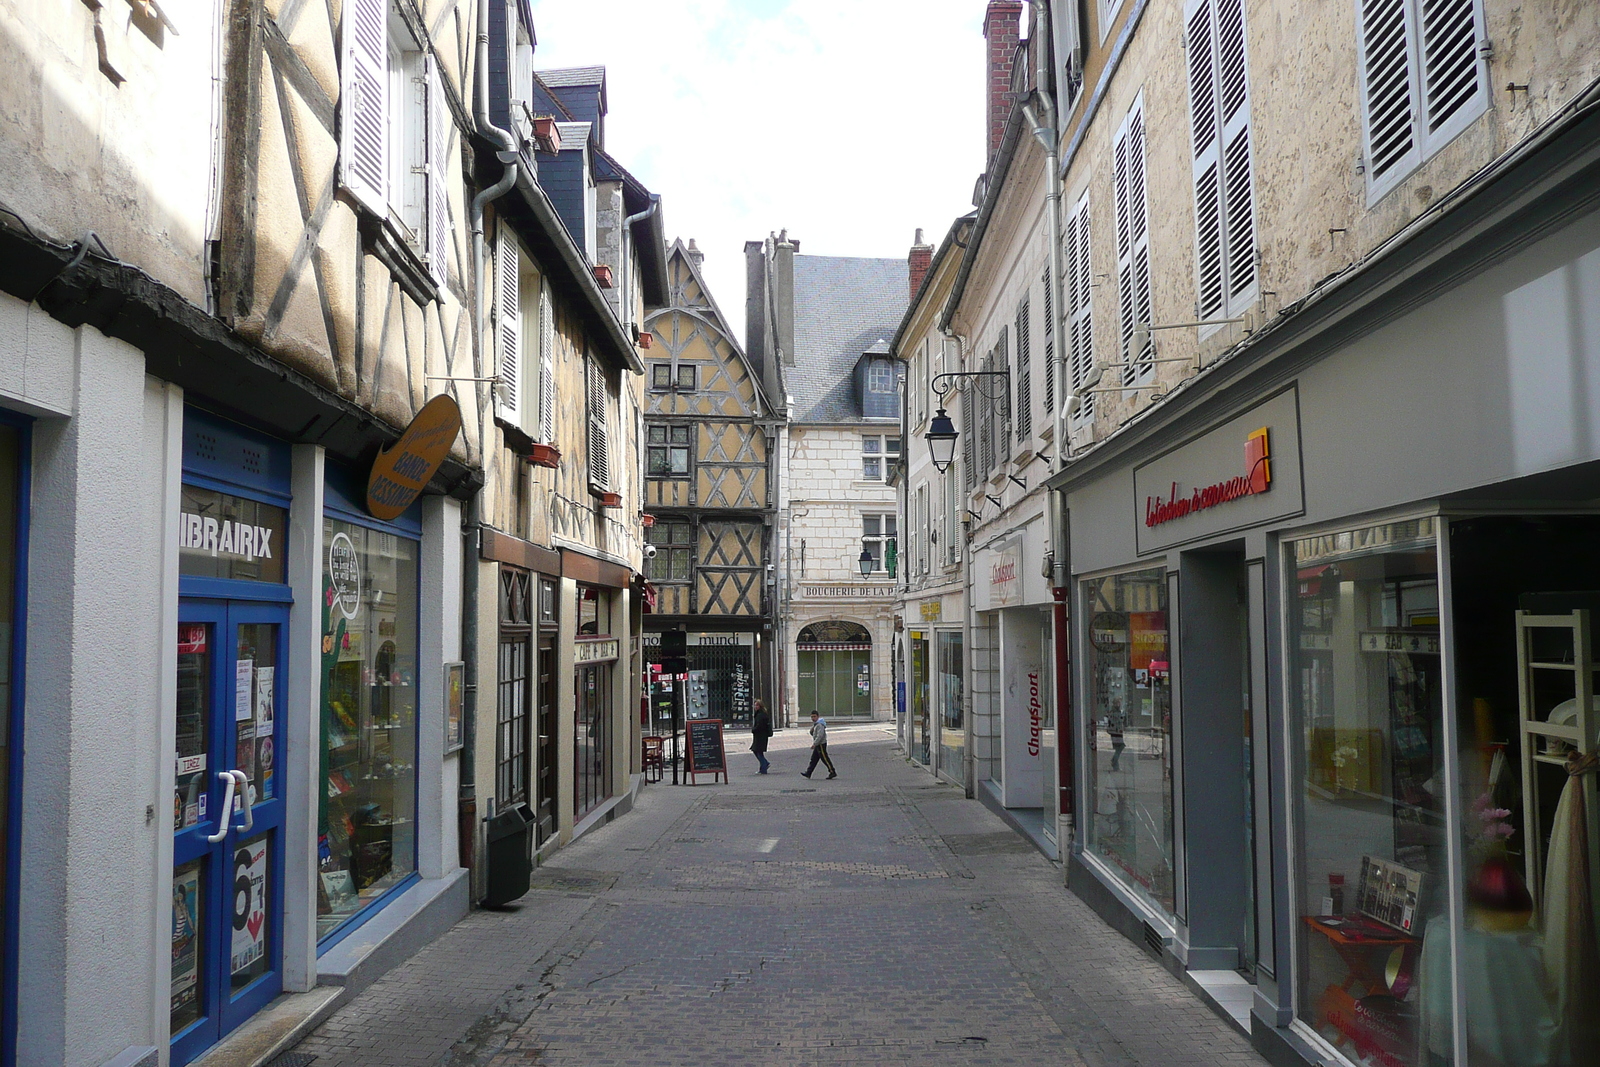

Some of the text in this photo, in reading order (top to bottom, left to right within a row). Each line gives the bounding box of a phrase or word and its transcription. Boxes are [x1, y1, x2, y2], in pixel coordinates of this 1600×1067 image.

[393, 451, 431, 482] BANDE
[1201, 475, 1255, 510] carreaux
[180, 512, 272, 562] IBRAIRIX
[806, 587, 856, 596] BOUCHERIE
[859, 587, 870, 596] DE
[873, 587, 884, 596] LA
[699, 636, 739, 646] mundi
[734, 663, 748, 704] Disques
[1028, 672, 1041, 757] Chausport
[183, 757, 200, 770] TIREZ
[232, 848, 253, 931] 6
